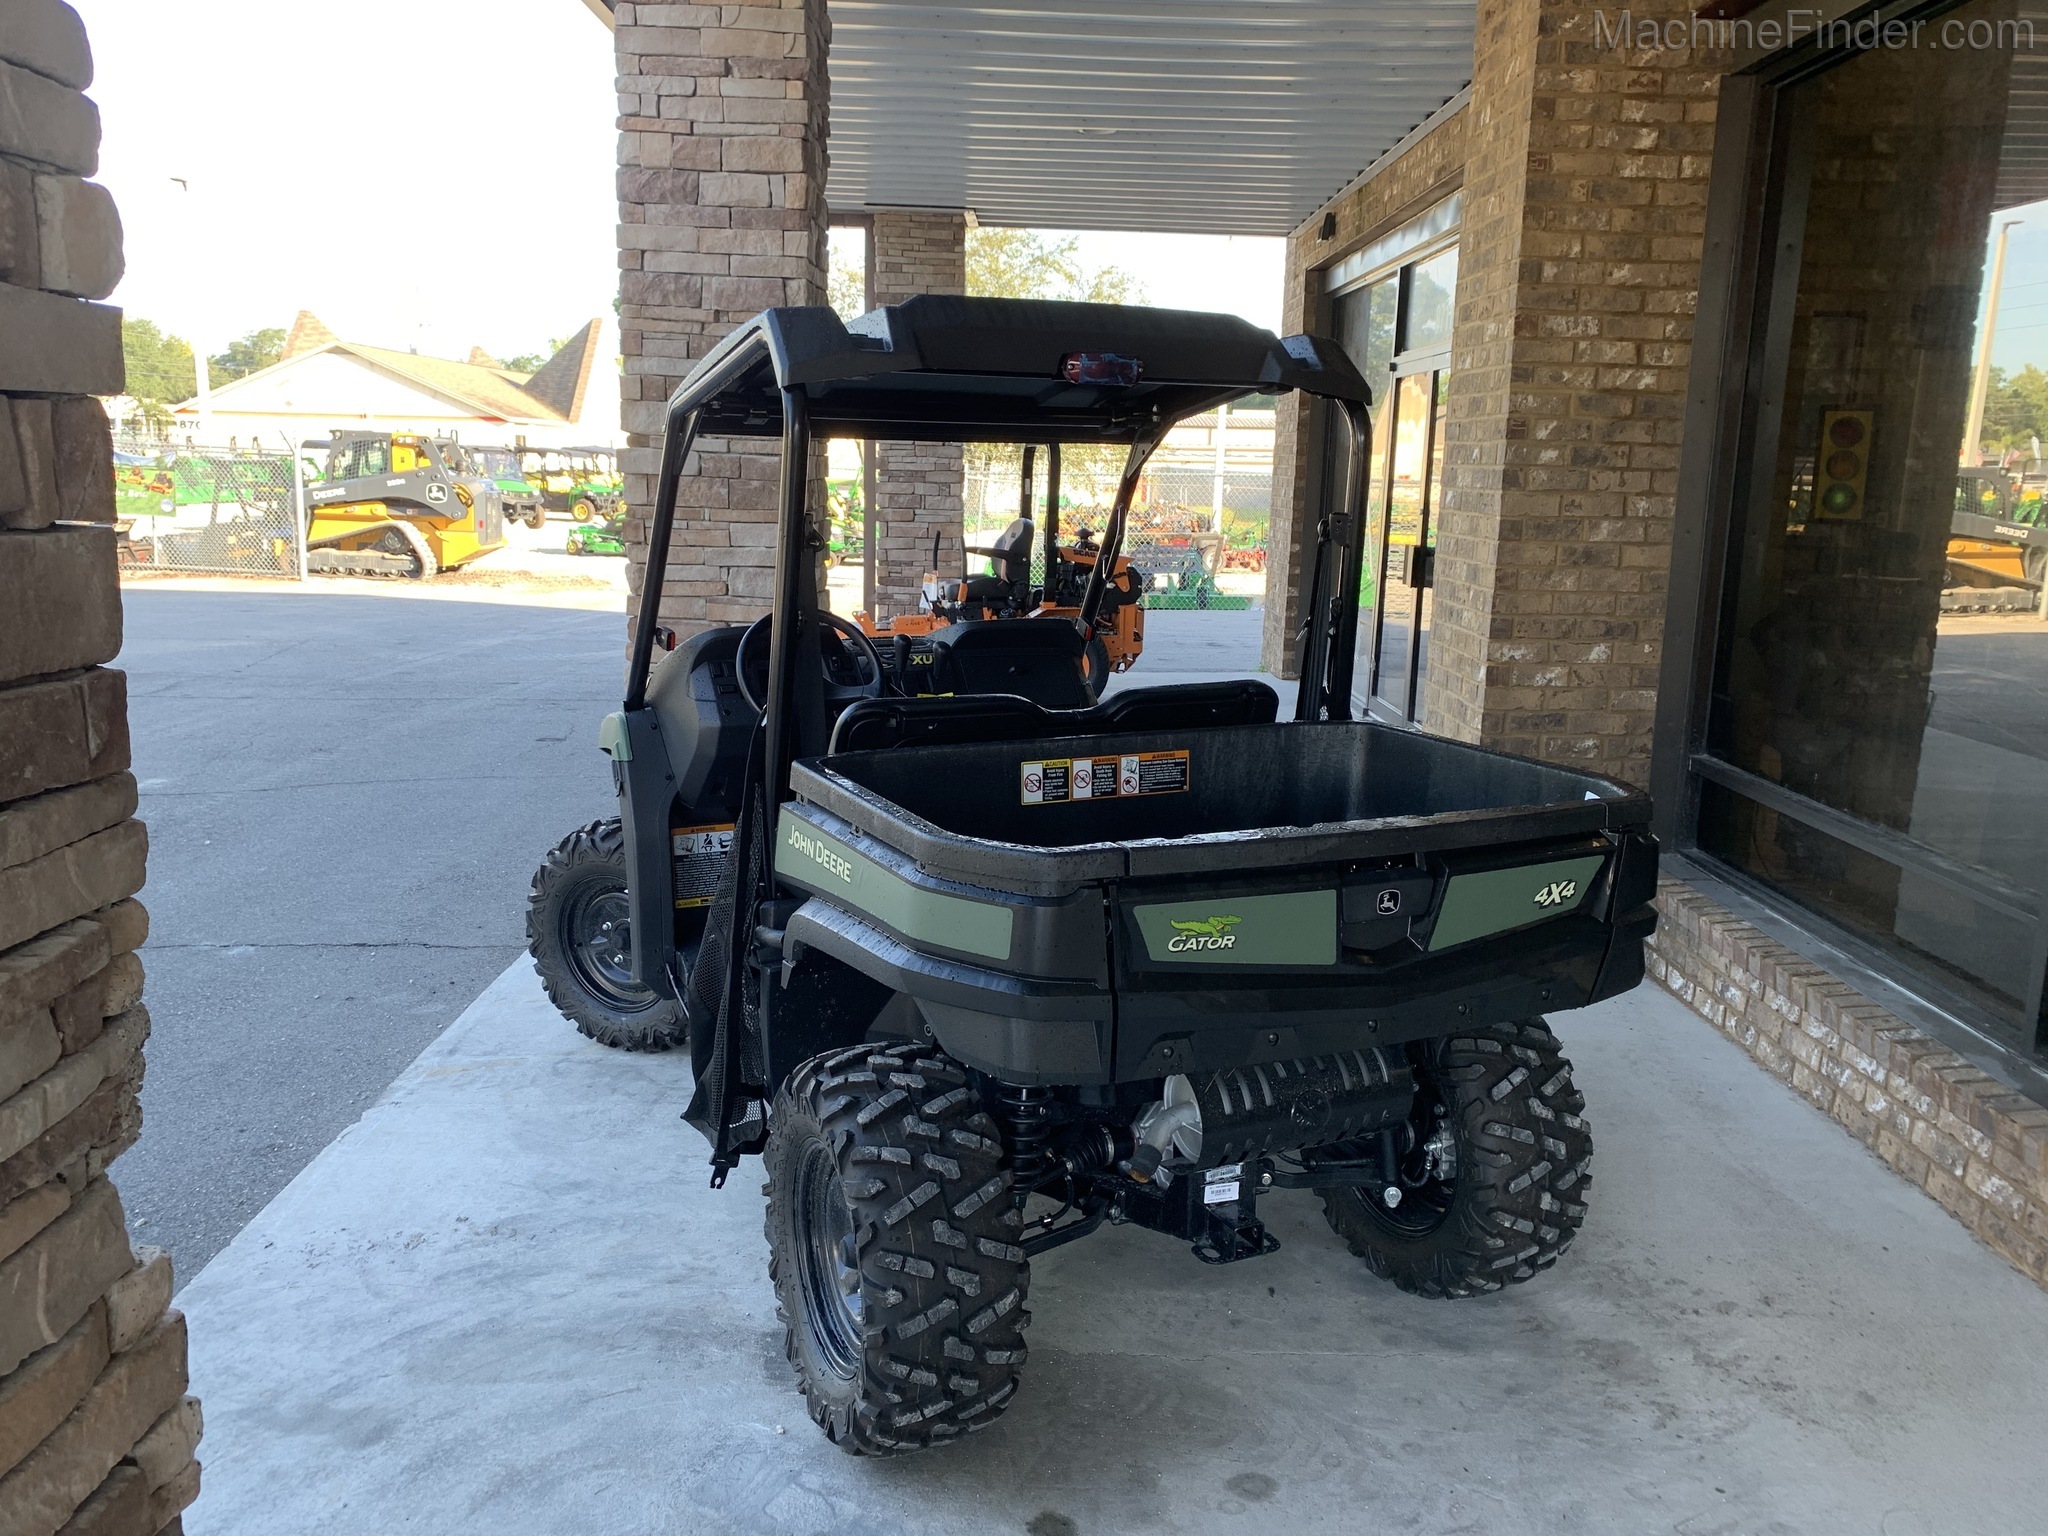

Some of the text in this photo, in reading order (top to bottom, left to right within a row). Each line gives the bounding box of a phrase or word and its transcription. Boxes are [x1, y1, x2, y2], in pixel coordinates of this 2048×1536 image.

[312, 487, 347, 500] DEERE
[1073, 549, 1096, 558] SCAG
[788, 824, 852, 883] JOHN DEERE
[1167, 934, 1237, 952] GATOR
